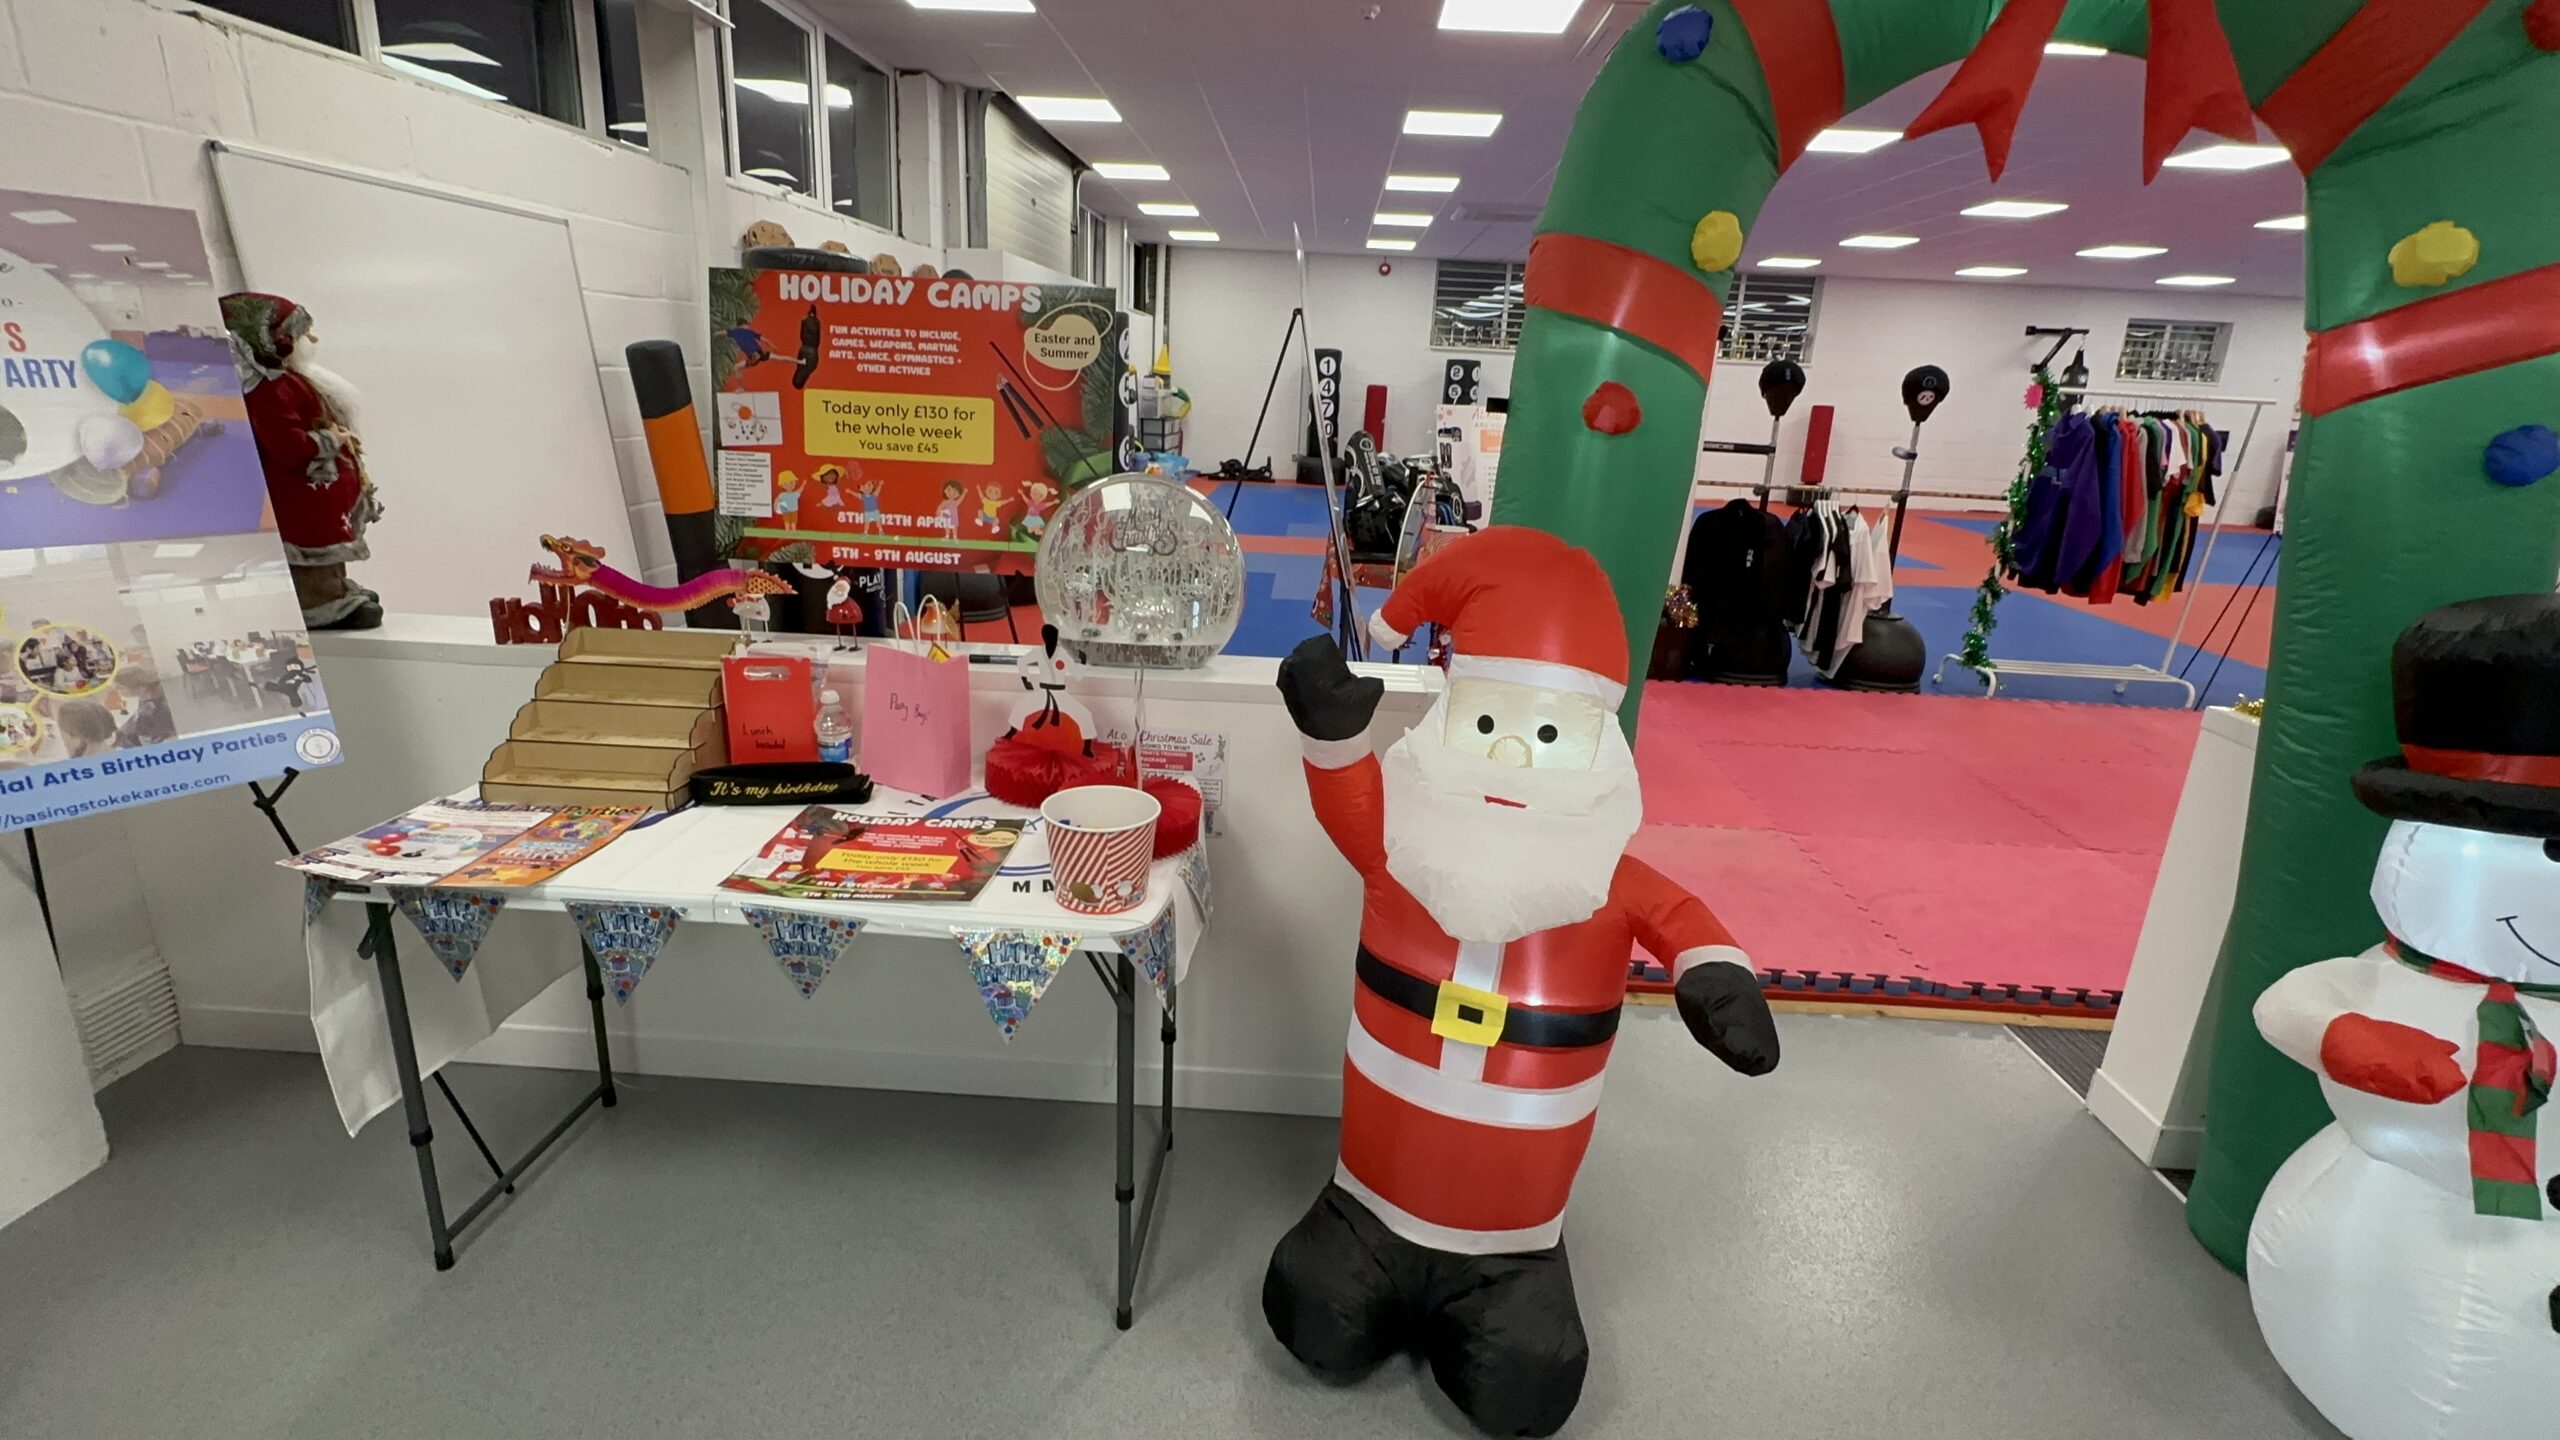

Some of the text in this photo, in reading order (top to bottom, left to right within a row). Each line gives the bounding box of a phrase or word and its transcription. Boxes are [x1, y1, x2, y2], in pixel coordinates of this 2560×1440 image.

[779, 273, 1042, 313] HOLIDAY CAMPS
[829, 325, 961, 341] FUN ACTIVITIES TO INCLUDE,
[1034, 332, 1096, 347] Easter and
[832, 338, 959, 352] GAMES, WEAPONS, MARTIAL
[858, 351, 891, 362] DANCE,
[894, 353, 954, 365] GYMNASTICS
[1040, 347, 1089, 360] Summer
[3, 358, 77, 388] ARTY
[857, 363, 931, 376] OTHER ACTIVIES
[1324, 358, 1331, 374] 1
[1453, 367, 1461, 378] 2
[1322, 380, 1331, 395] 4
[1451, 387, 1459, 397] 5
[822, 400, 976, 421] Today only £130 for
[1321, 402, 1331, 416] 7
[835, 420, 963, 439] the whole week
[859, 440, 939, 454] You save £45
[837, 511, 863, 524] 8TH
[916, 516, 955, 529] APRIL
[832, 546, 859, 559] 5TH
[874, 548, 901, 562] 9TH
[905, 551, 961, 565] AUGUST
[742, 722, 773, 736] Lunch
[1140, 729, 1188, 744] Christmas
[1190, 733, 1213, 746] Sale
[43, 765, 95, 788] Arts
[101, 745, 205, 776] Birthday
[212, 730, 288, 755] Parties
[709, 781, 838, 798] It's my birthday
[563, 804, 640, 816] Parties
[832, 812, 998, 829] HOLIDAY CAMPS
[876, 854, 897, 862] only
[597, 911, 658, 936] HAPPY
[775, 919, 834, 944] HAPPY
[769, 939, 840, 962] BIRTHDAY
[987, 940, 1048, 966] HAPPY
[978, 963, 1053, 988] BIRTHDAY
